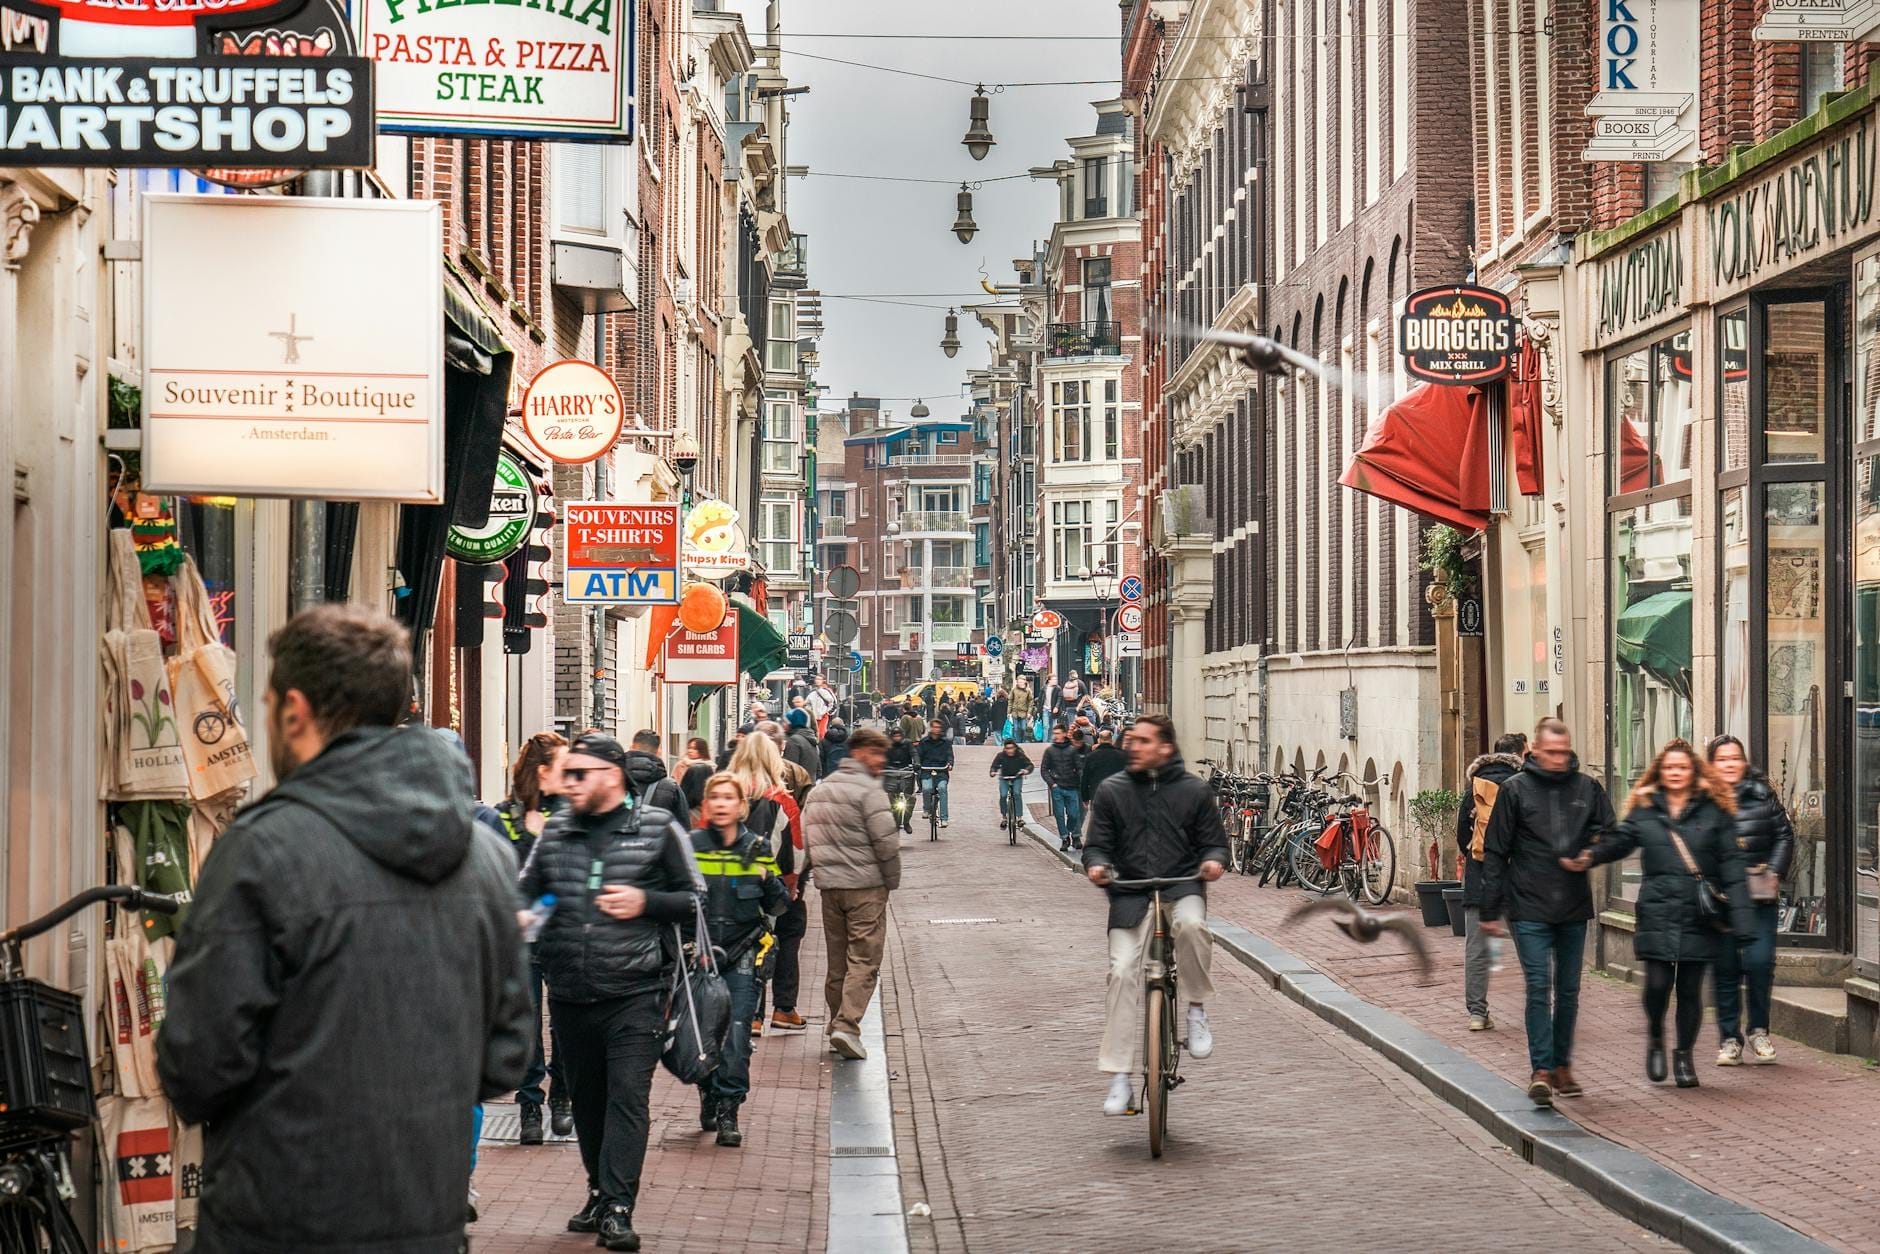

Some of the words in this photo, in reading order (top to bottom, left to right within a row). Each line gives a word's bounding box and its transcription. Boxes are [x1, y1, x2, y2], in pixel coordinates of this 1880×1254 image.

[1799, 14, 1805, 24] &
[1799, 30, 1848, 39] PRENTEN
[373, 34, 476, 65] PASTA
[485, 38, 505, 67] &
[516, 41, 610, 72] PIZZA
[12, 67, 123, 103] BANK
[127, 77, 149, 103] &
[149, 67, 354, 105] TRUFFELS
[437, 72, 544, 104] STEAK
[0, 105, 352, 152] ARTSHOP
[1604, 123, 1650, 134] BOOKS
[1632, 152, 1661, 160] PRINTS
[1406, 319, 1510, 351] BURGERS
[1430, 361, 1452, 370] MIX
[1454, 361, 1486, 370] GRILL
[164, 381, 279, 405] Souvenir
[302, 384, 416, 415] Boutique
[531, 394, 616, 417] HARRY'S
[543, 425, 574, 441] Pasta
[578, 425, 603, 440] Bar
[568, 509, 674, 525] SOUVENIRS
[578, 528, 663, 544] T-SHIRTS
[720, 555, 746, 567] King
[584, 573, 659, 597] ATM
[677, 644, 694, 654] SIM
[696, 644, 725, 655] CARDS
[789, 635, 810, 650] STACH
[1516, 681, 1525, 692] 20
